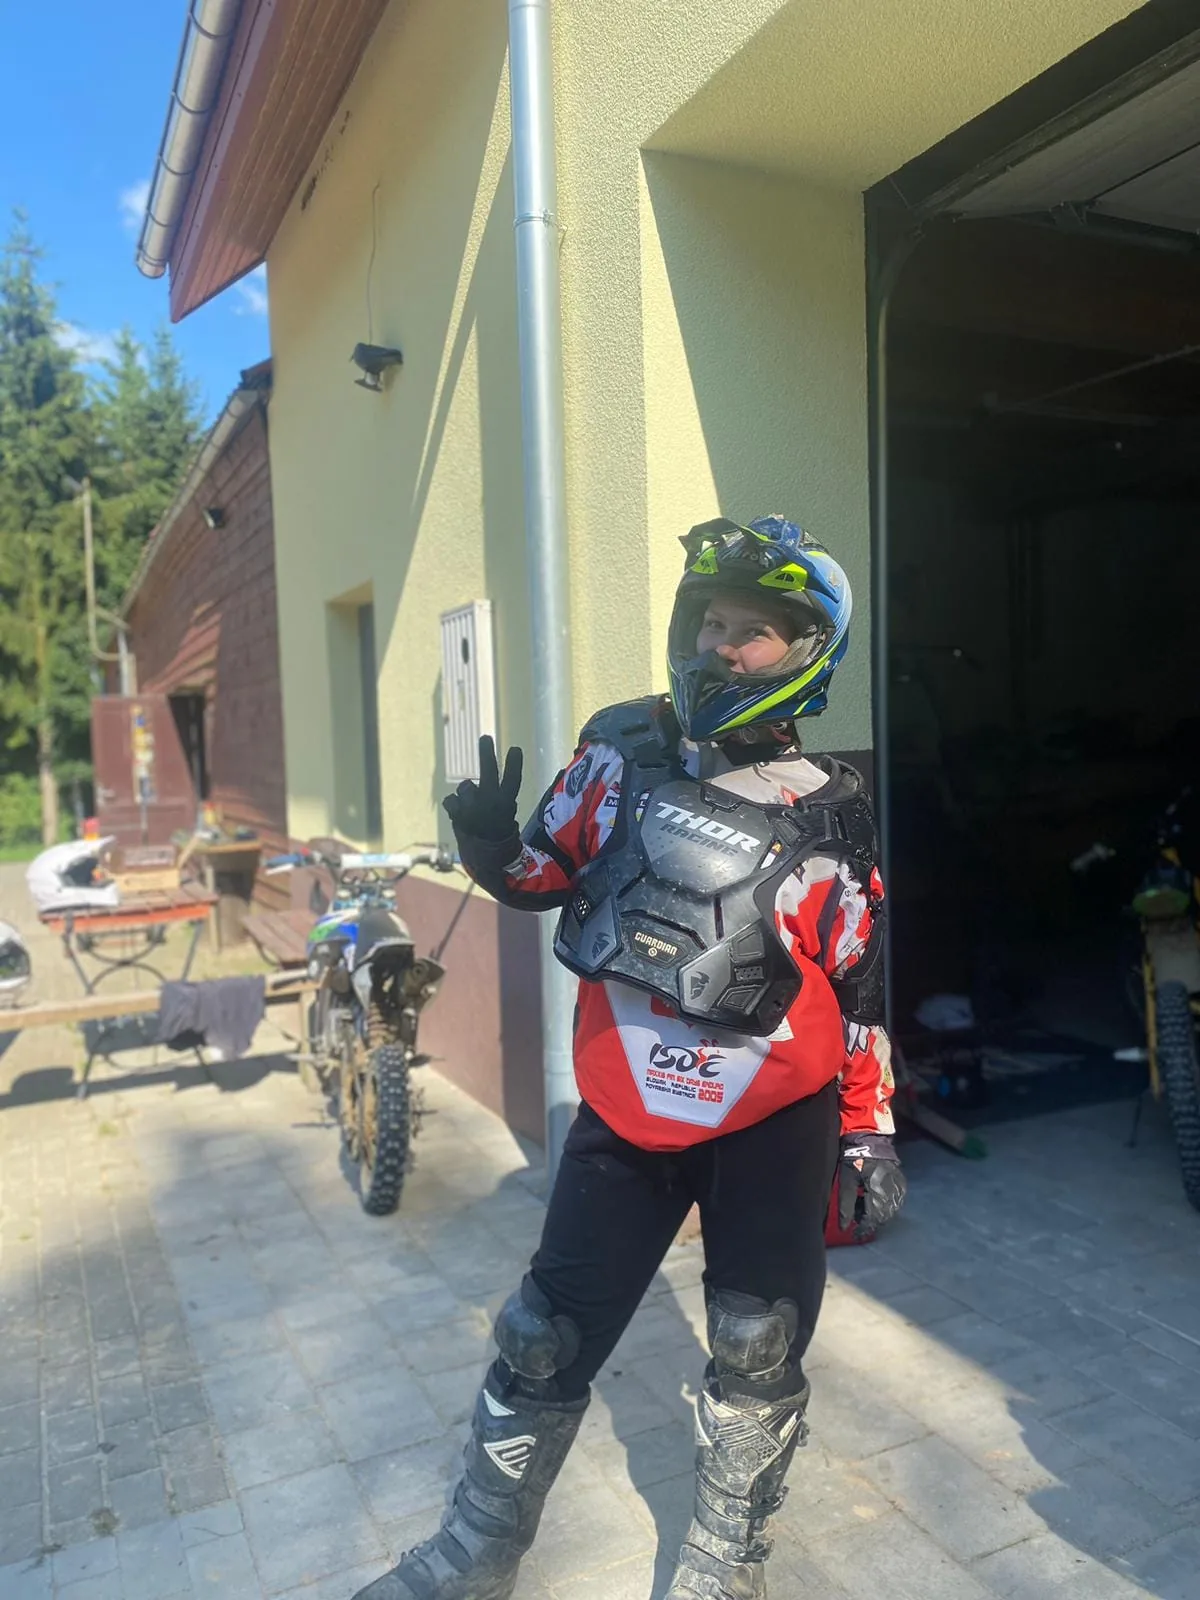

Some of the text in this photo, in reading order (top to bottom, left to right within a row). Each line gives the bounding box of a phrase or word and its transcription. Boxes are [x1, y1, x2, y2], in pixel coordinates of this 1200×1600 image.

[656, 802, 760, 853] THOR
[660, 823, 738, 857] RACING
[634, 931, 678, 956] GUARDIAN
[697, 1088, 724, 1104] 2005
